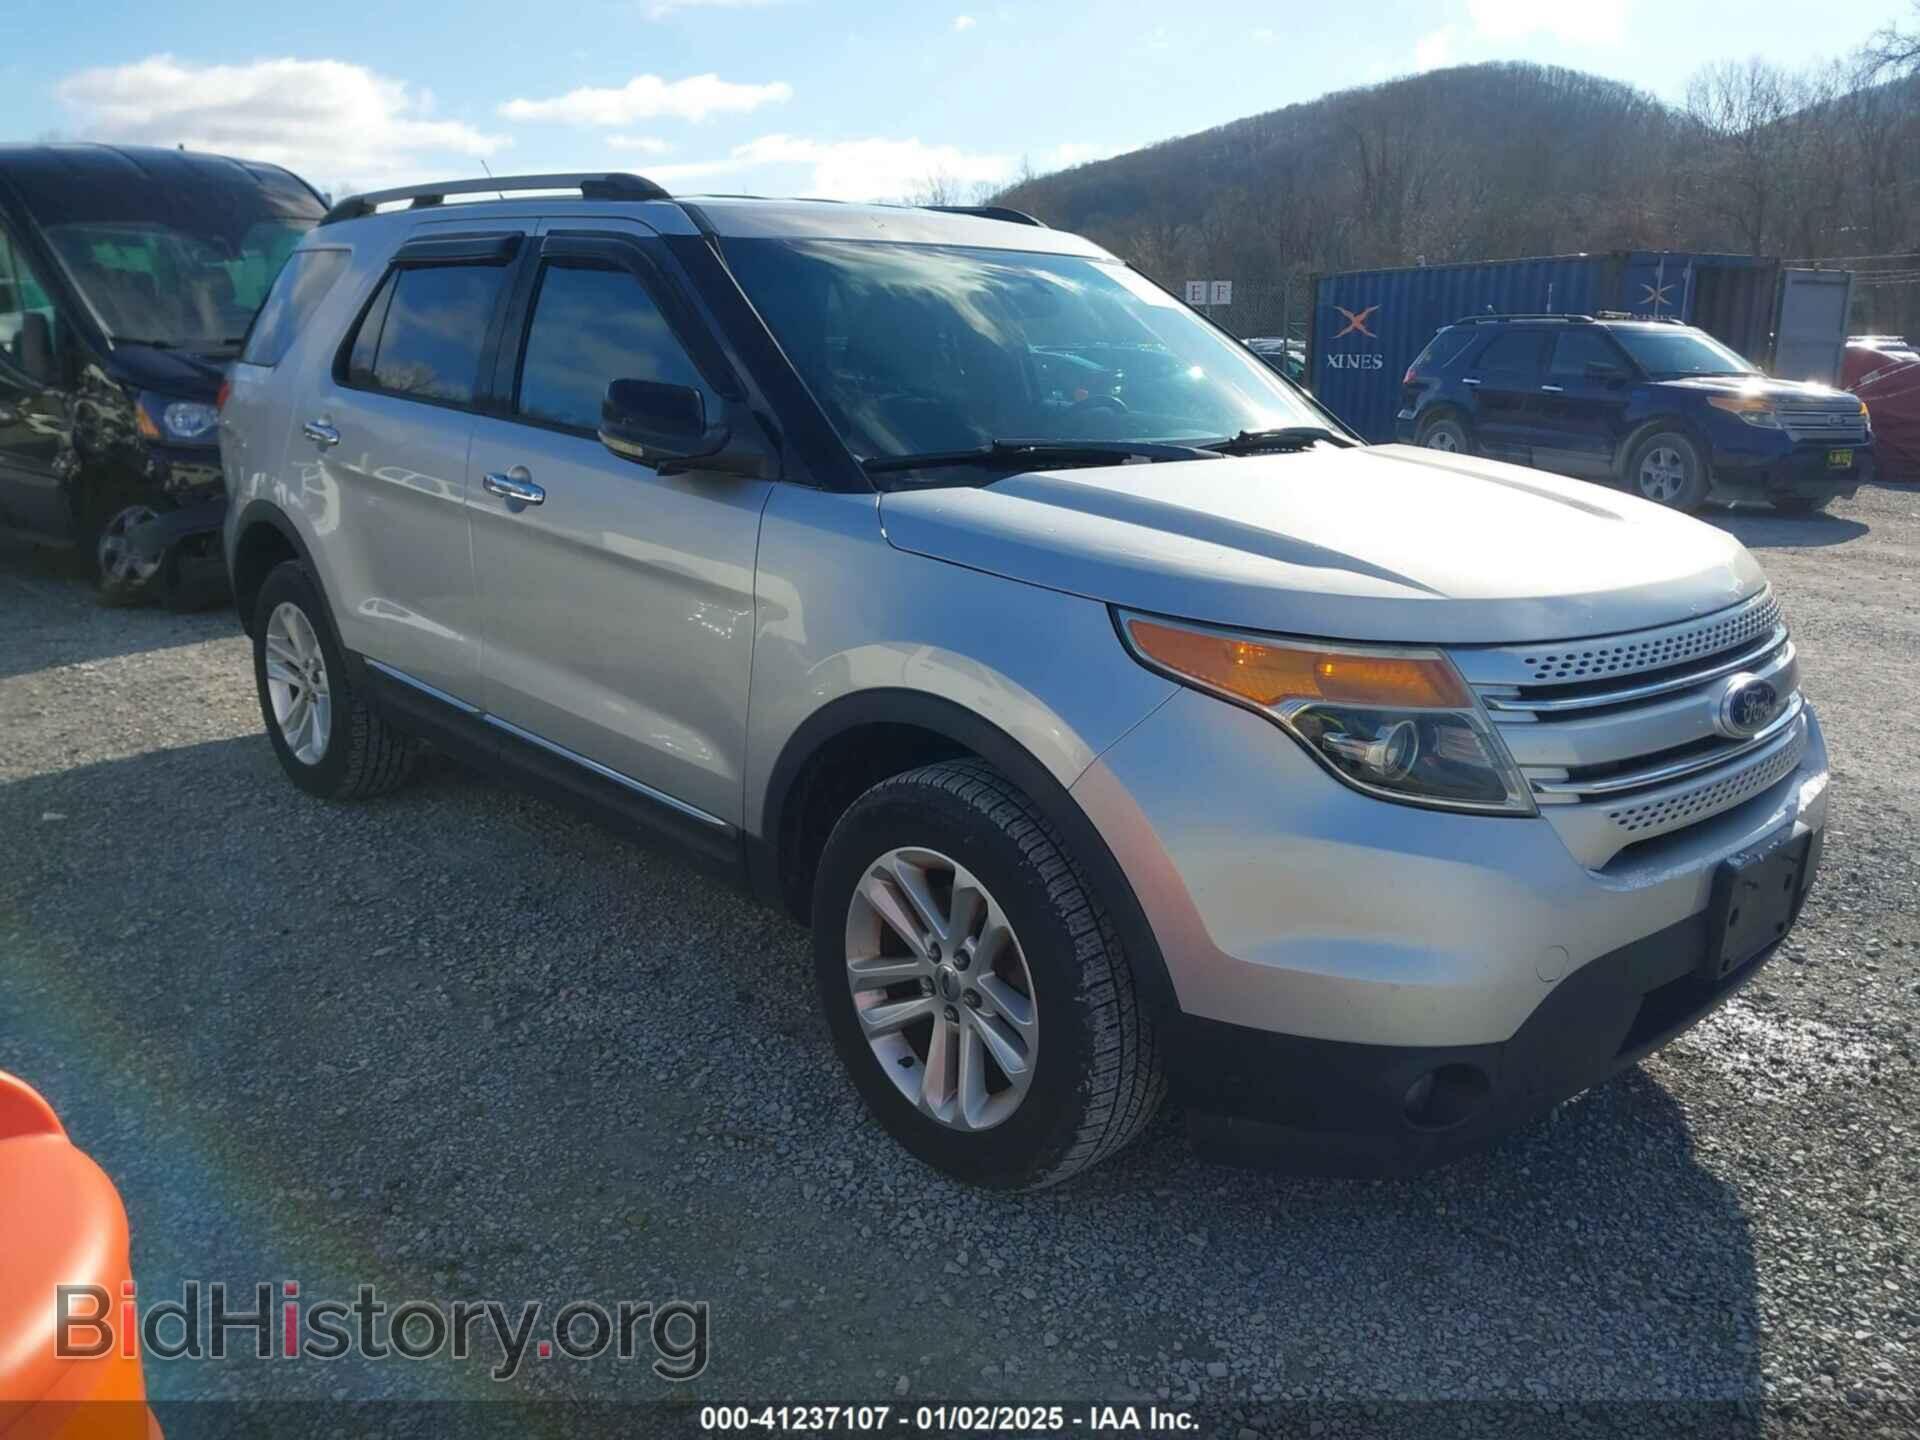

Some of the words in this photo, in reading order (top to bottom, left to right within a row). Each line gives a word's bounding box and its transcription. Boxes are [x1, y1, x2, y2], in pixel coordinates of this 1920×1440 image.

[1216, 284, 1227, 301] F
[1327, 353, 1383, 369] XINES
[1743, 688, 1774, 724] Ford
